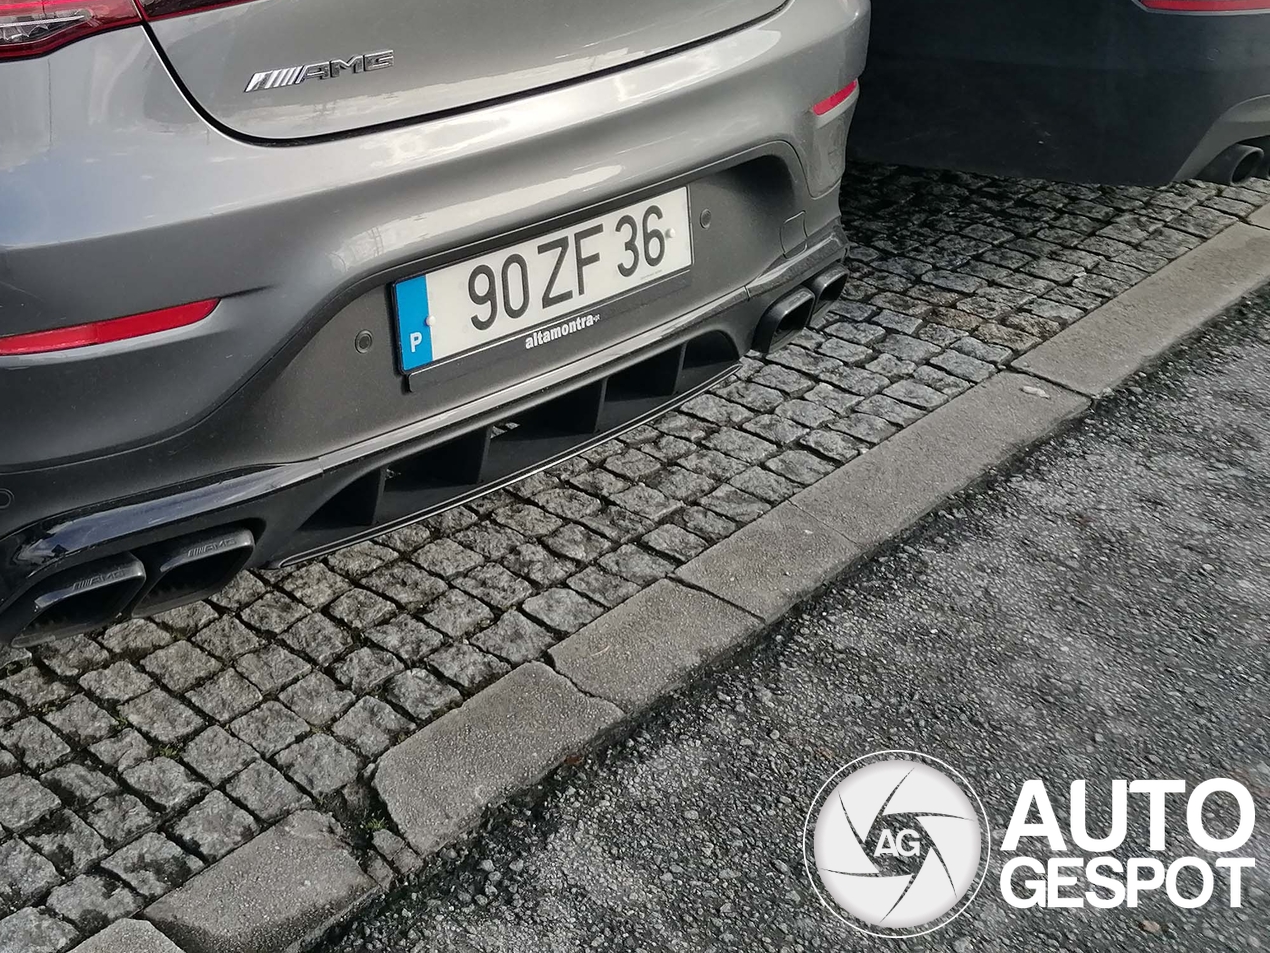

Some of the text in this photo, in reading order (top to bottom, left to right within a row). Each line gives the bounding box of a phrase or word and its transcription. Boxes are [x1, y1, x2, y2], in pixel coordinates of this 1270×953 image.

[296, 49, 394, 84] AMG
[615, 205, 666, 278] 36
[410, 331, 423, 353] P
